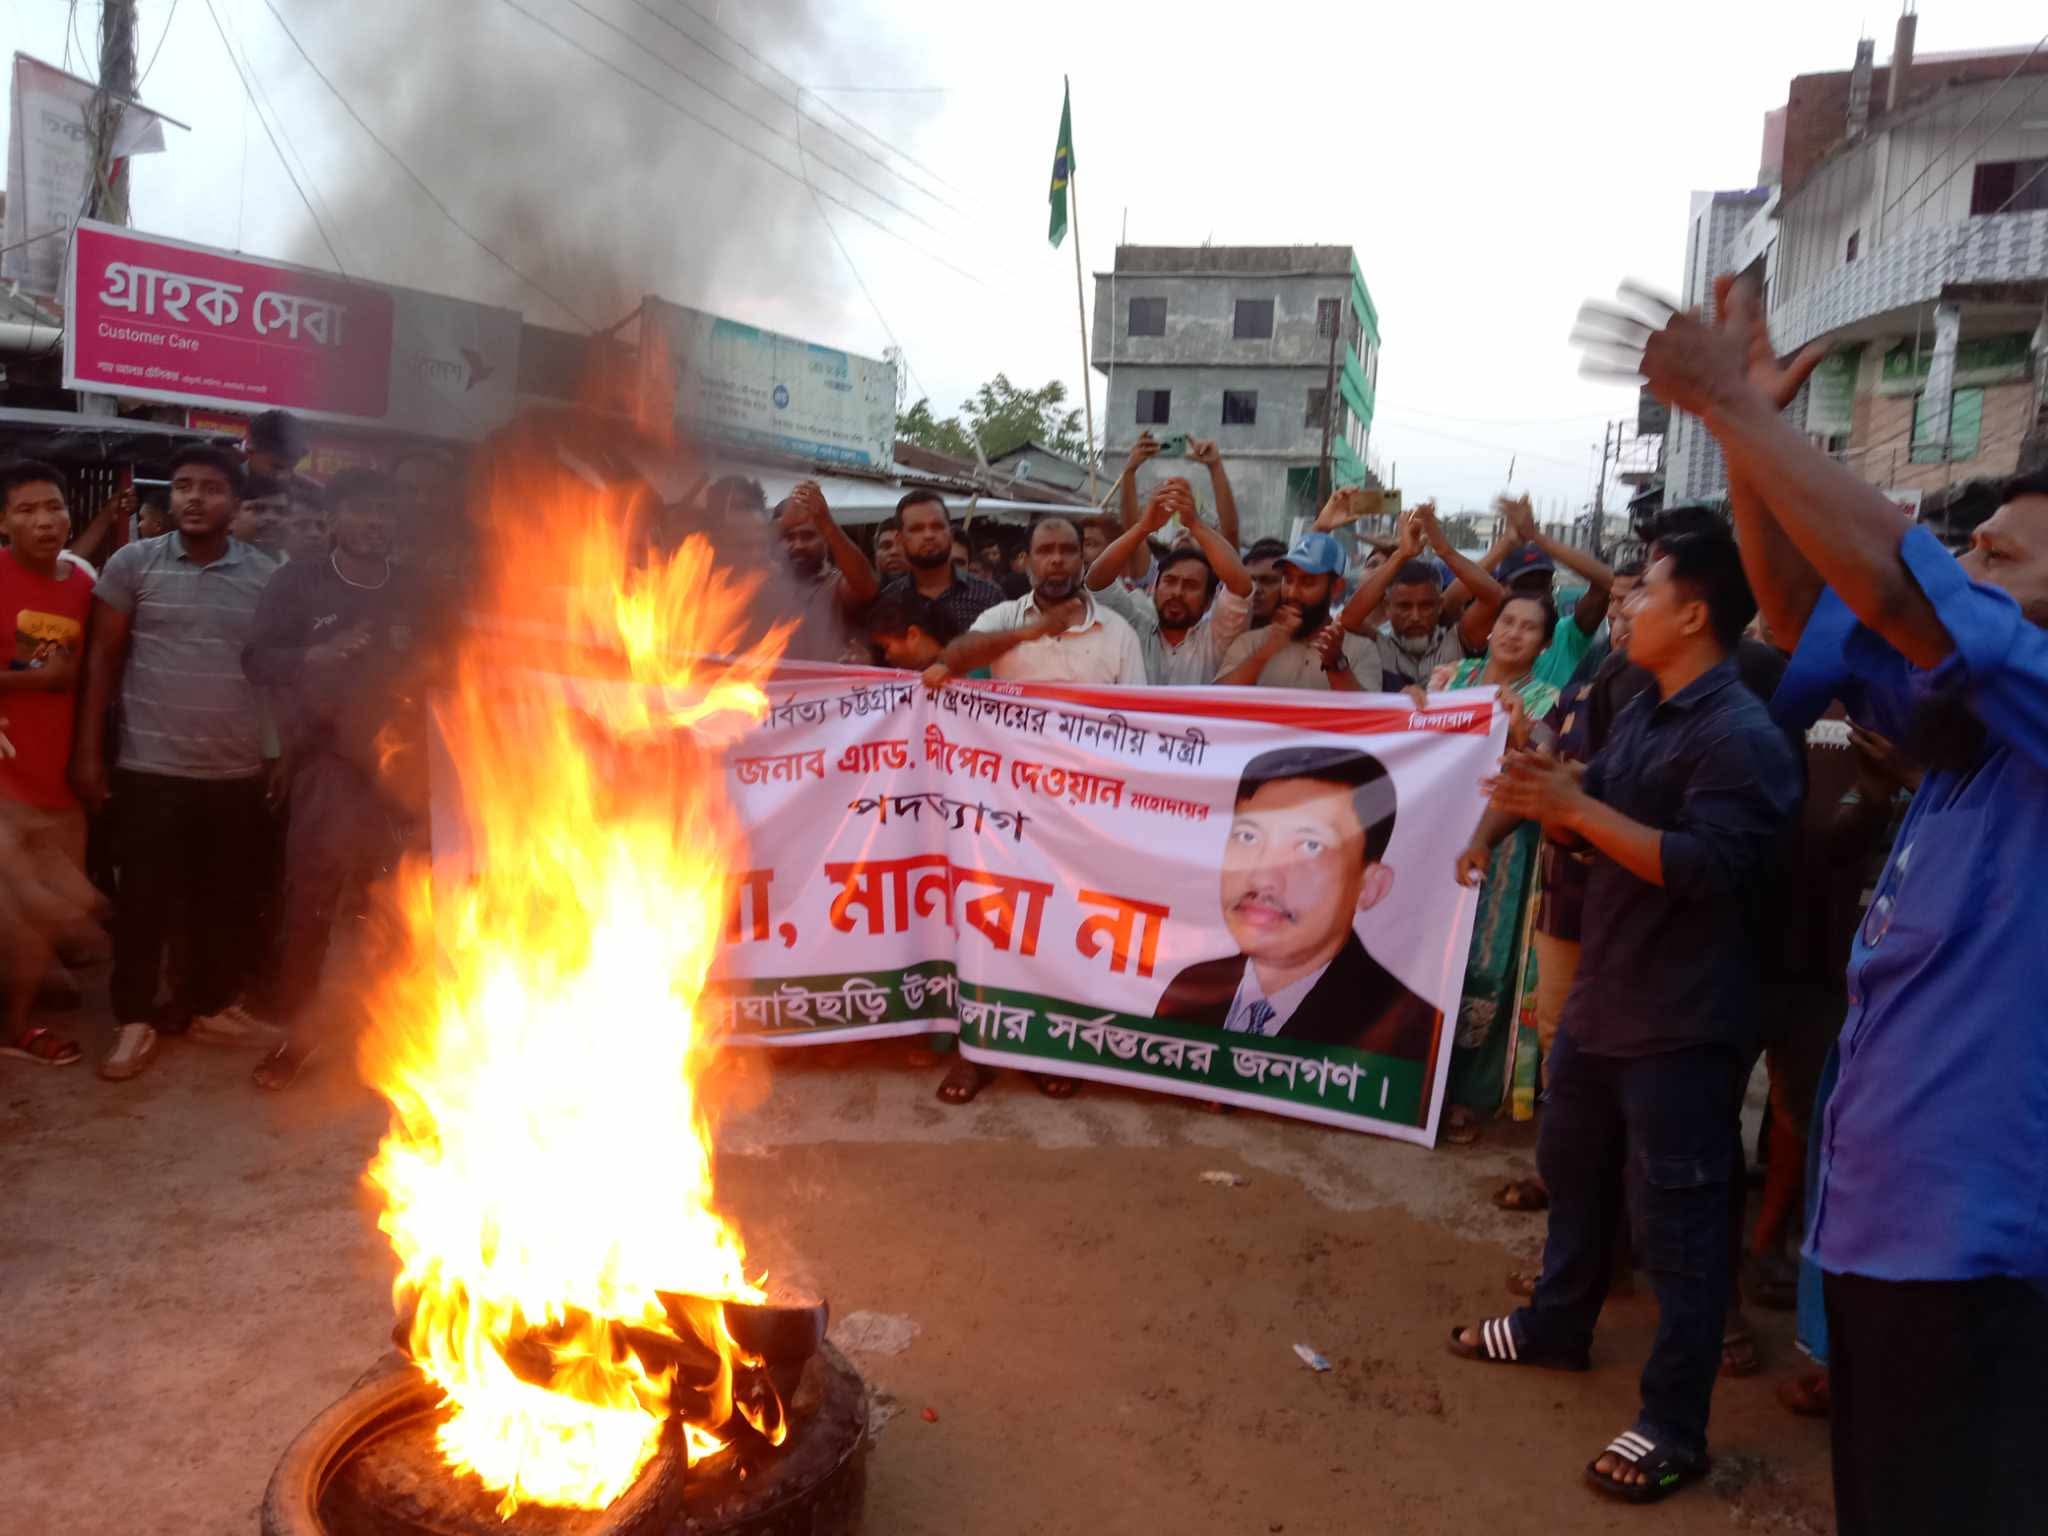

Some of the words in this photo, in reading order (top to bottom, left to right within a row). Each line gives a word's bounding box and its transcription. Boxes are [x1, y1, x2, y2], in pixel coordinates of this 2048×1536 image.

[98, 322, 165, 346] Customer
[168, 334, 200, 351] Care
[99, 261, 244, 326] গ্রাহক
[252, 291, 348, 346] সেবা
[763, 692, 827, 729] ার্বত্য
[839, 683, 914, 718] চট্টগ্রাম
[1058, 713, 1148, 756] মাননীয়
[1157, 726, 1210, 766] মন্ত্রী
[734, 748, 826, 785] জনাব
[838, 739, 916, 774] এ্যাড.
[923, 723, 1001, 785] দীপেন
[1011, 759, 1125, 809] দেওয়ান
[1130, 792, 1210, 822] মহোদয়ের
[847, 792, 1032, 843] পদত্যাগ
[1075, 888, 1170, 978] না
[731, 977, 892, 1027] াঘাইছড়ি
[1044, 1013, 1219, 1075] সর্বস্তরের
[1230, 1047, 1367, 1102] জনগণ
